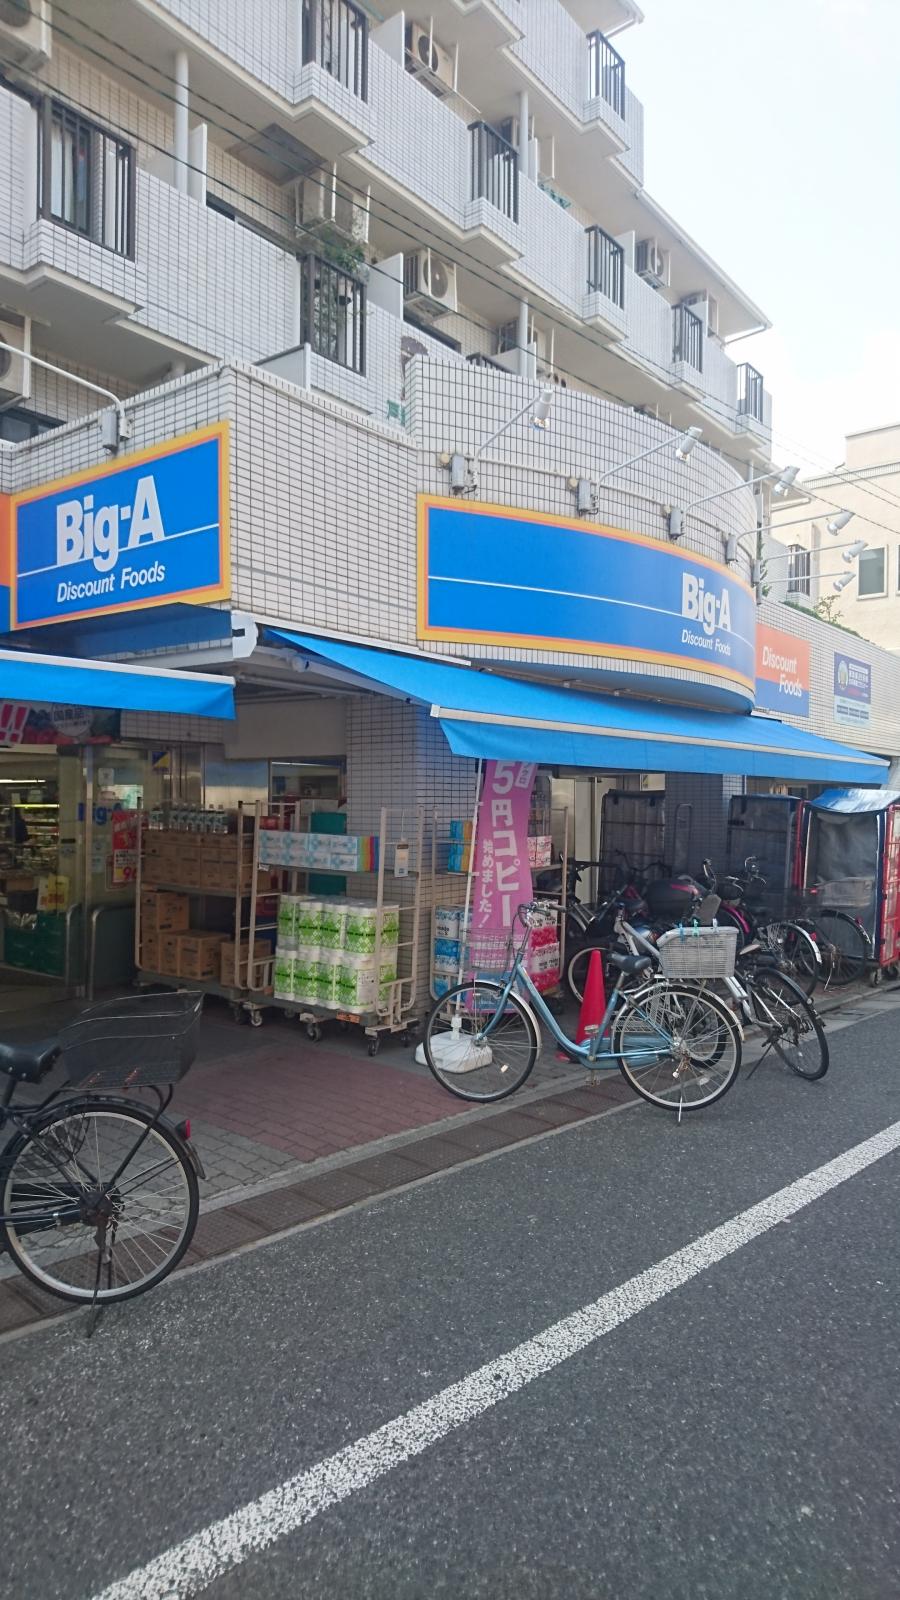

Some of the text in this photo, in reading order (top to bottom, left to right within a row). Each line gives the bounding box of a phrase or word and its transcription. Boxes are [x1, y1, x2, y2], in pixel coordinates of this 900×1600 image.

[57, 475, 165, 572] Big-A
[57, 560, 166, 603] Discount Foods
[682, 572, 731, 635] Big-A
[681, 629, 731, 656] Discount Foods
[762, 645, 797, 674] Discount
[778, 673, 802, 697] Foods
[491, 761, 521, 927] 5円コピー
[478, 838, 494, 928] 始めました!
